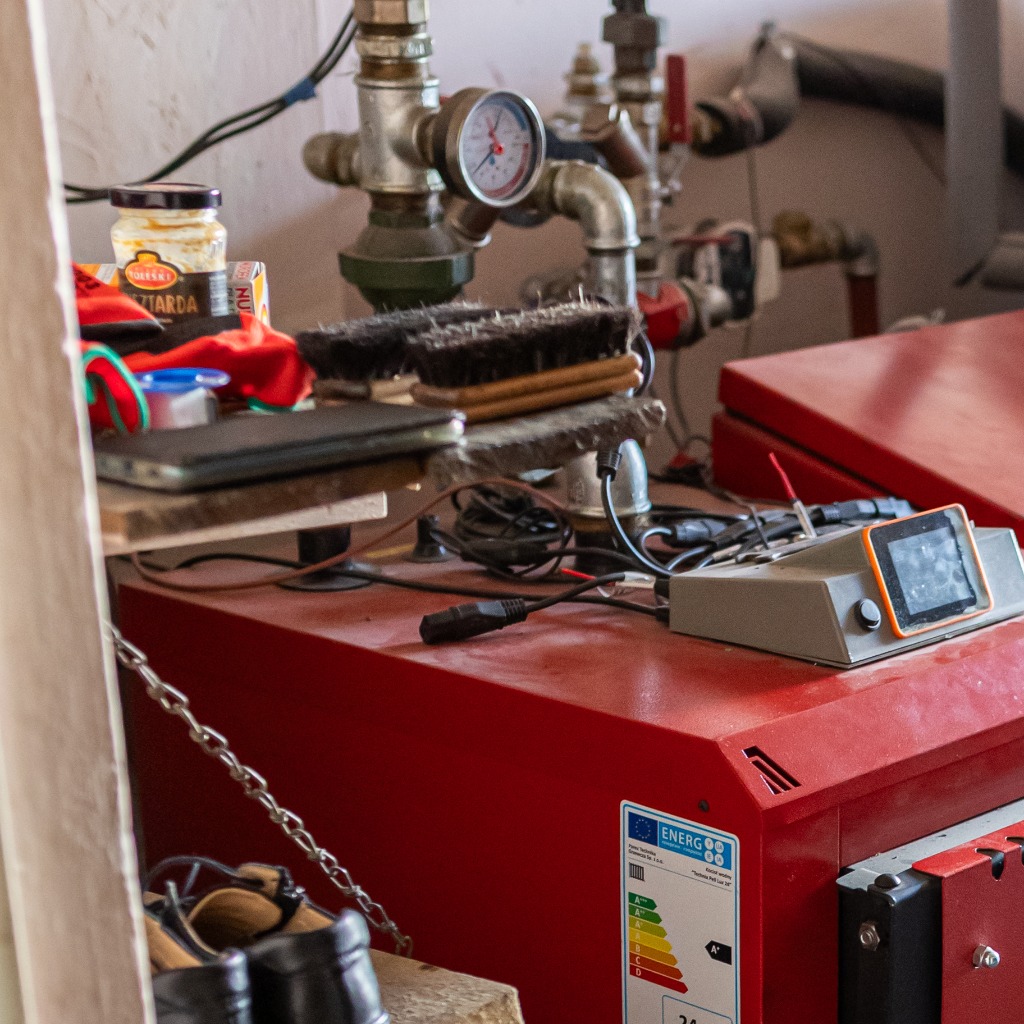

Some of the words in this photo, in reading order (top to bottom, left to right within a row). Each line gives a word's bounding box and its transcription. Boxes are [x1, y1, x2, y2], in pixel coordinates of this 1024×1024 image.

[234, 287, 251, 313] NU
[662, 826, 702, 850] ENERG
[710, 944, 720, 955] A+
[635, 956, 641, 965] C
[635, 968, 642, 977] D
